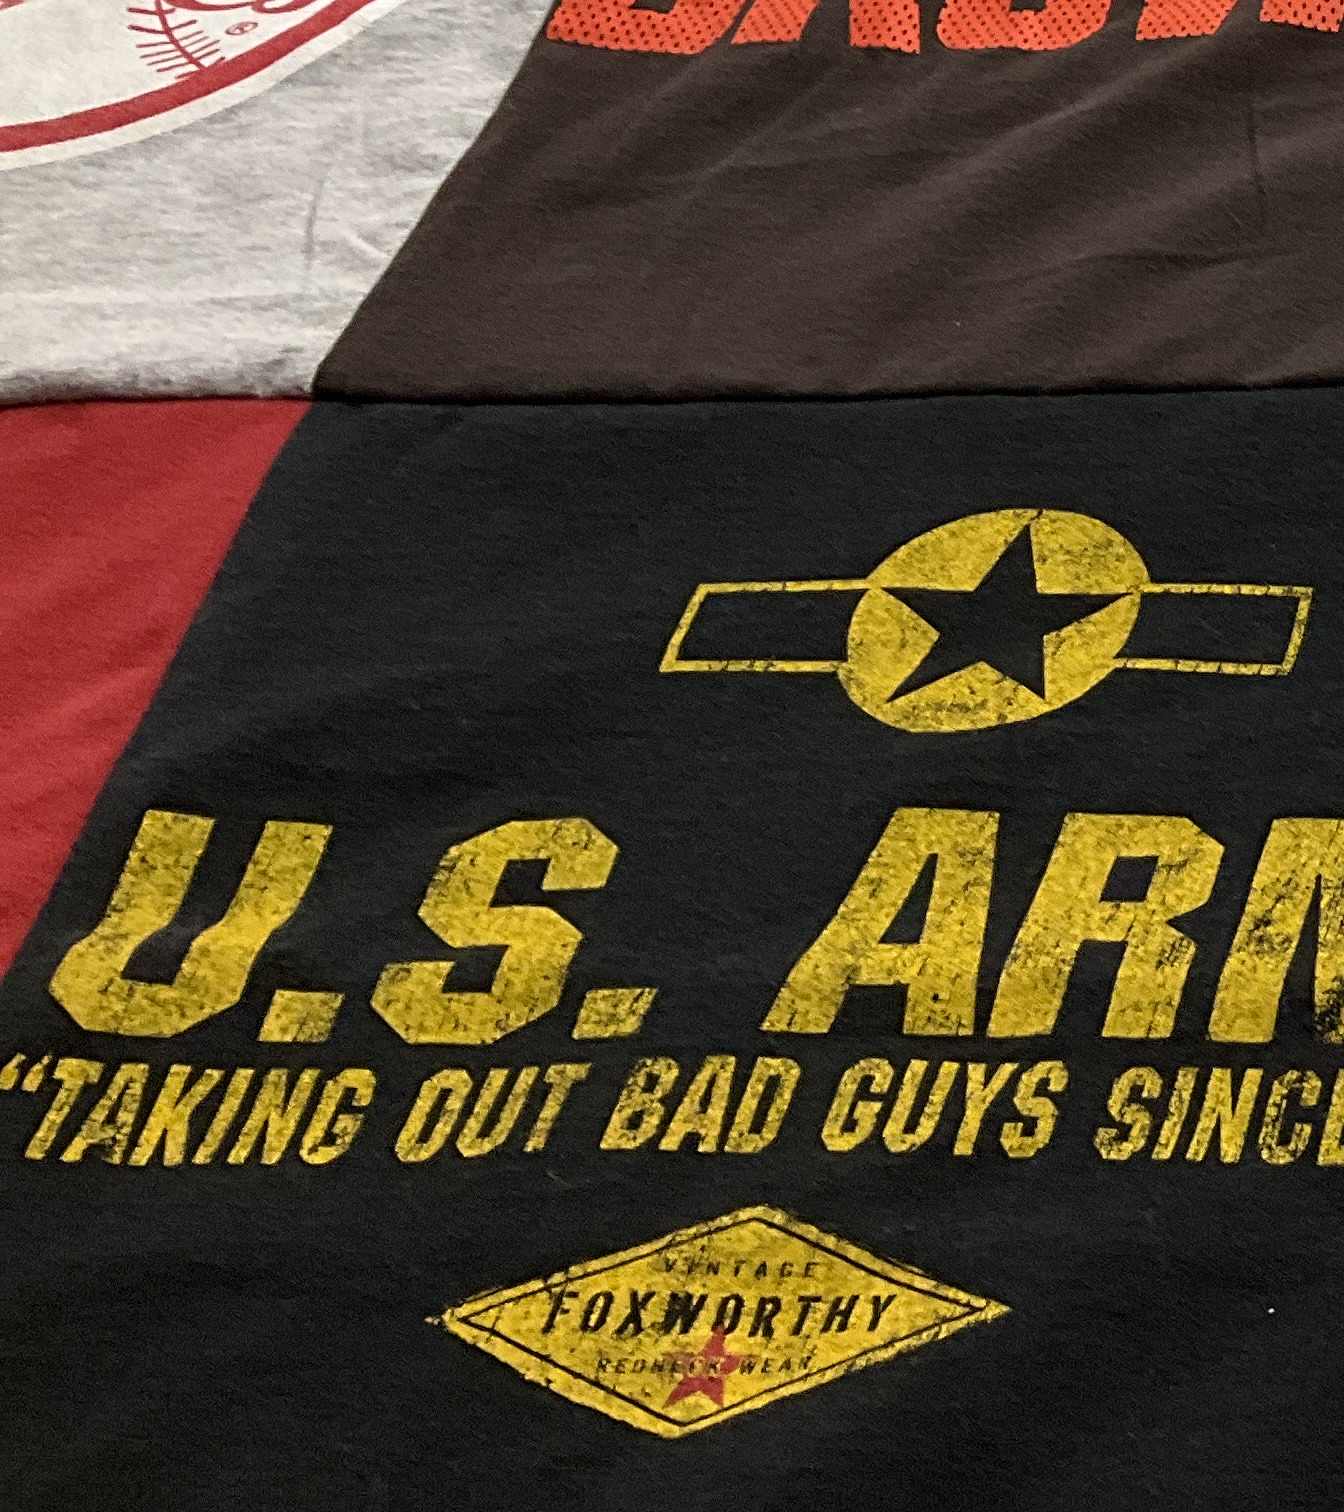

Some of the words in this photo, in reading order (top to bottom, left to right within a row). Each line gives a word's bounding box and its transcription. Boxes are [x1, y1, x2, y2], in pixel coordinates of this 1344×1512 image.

[46, 808, 661, 1047] U.S.
[389, 1060, 597, 1165] OUT
[598, 1054, 804, 1158] BAD
[821, 1058, 1071, 1164] GUYS
[661, 1257, 820, 1280] VINTAGE
[540, 1288, 898, 1338] FOXWORTHY
[737, 1354, 816, 1376] WEAR
